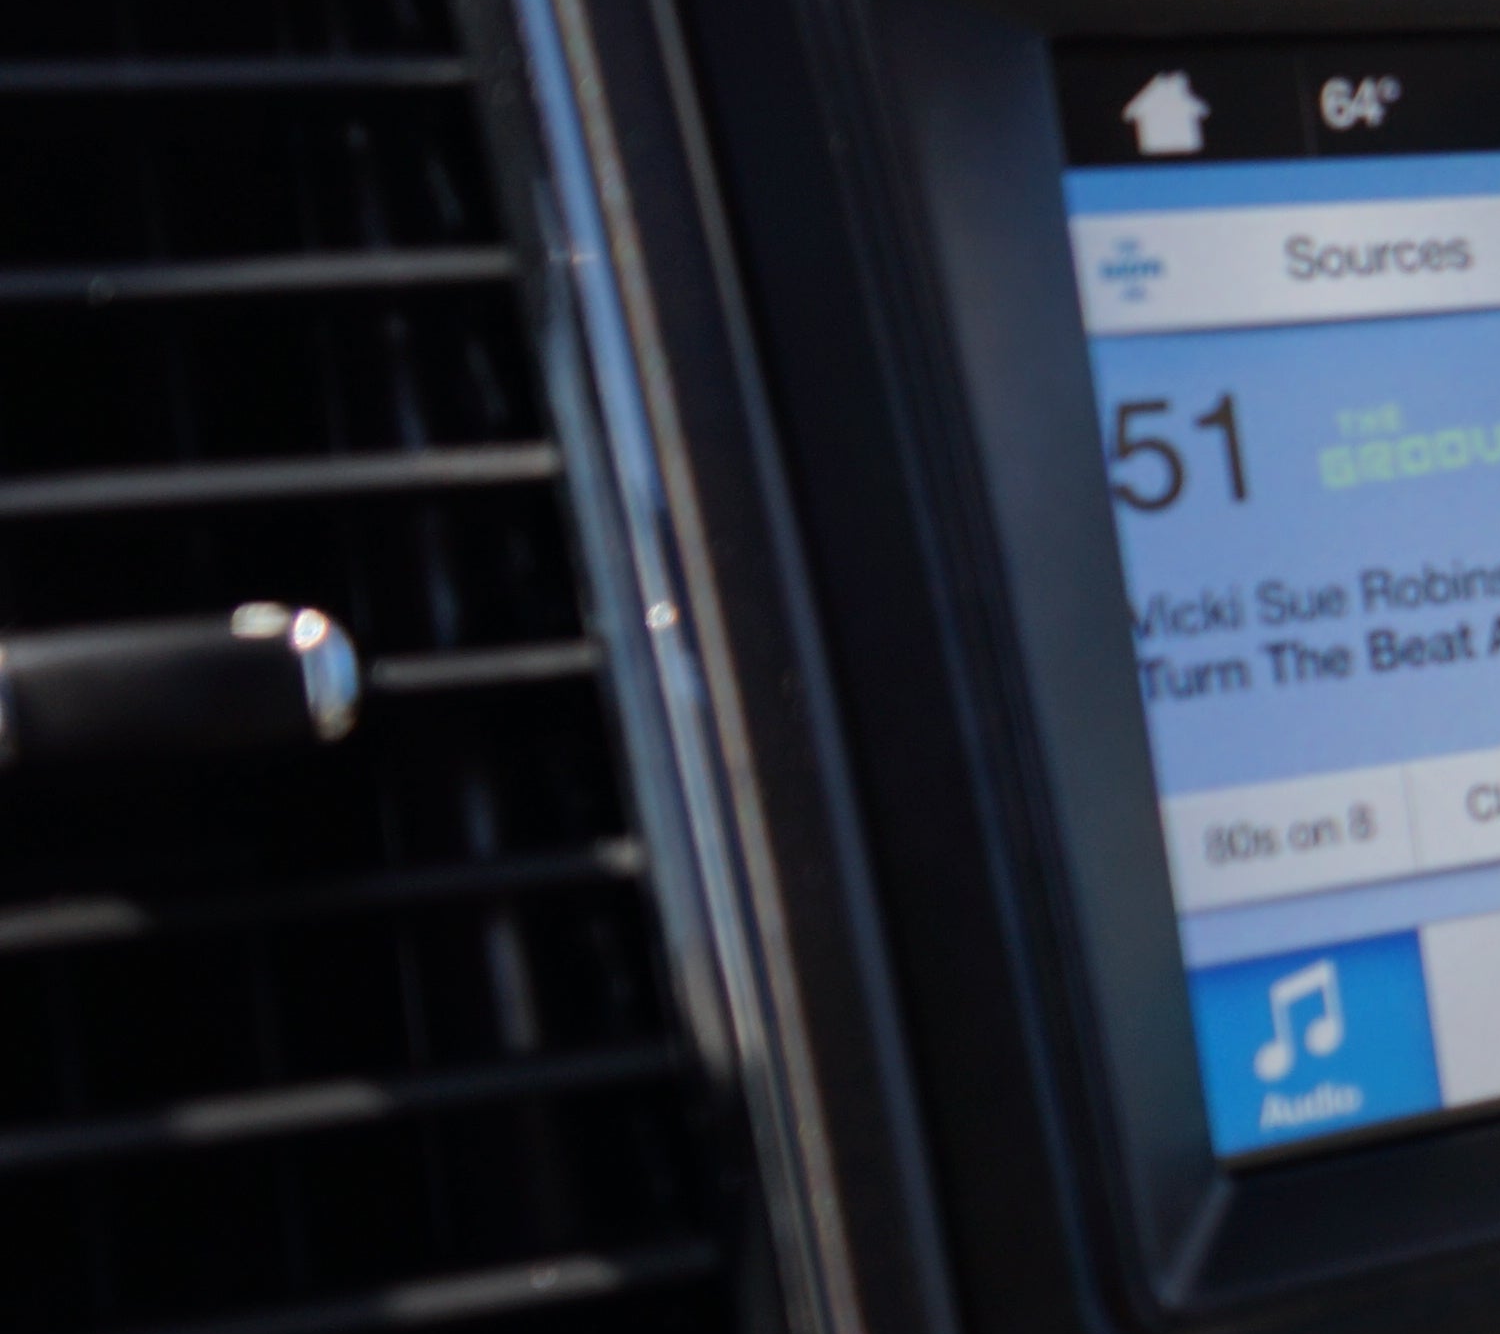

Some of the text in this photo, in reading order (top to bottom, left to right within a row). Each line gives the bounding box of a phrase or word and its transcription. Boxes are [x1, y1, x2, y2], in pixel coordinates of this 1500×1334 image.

[1284, 234, 1474, 281] Sources
[1111, 389, 1249, 514] 51
[1255, 577, 1351, 627] Sue
[1138, 650, 1252, 701] Turn
[1264, 637, 1353, 685] The
[1367, 624, 1475, 671] Beat
